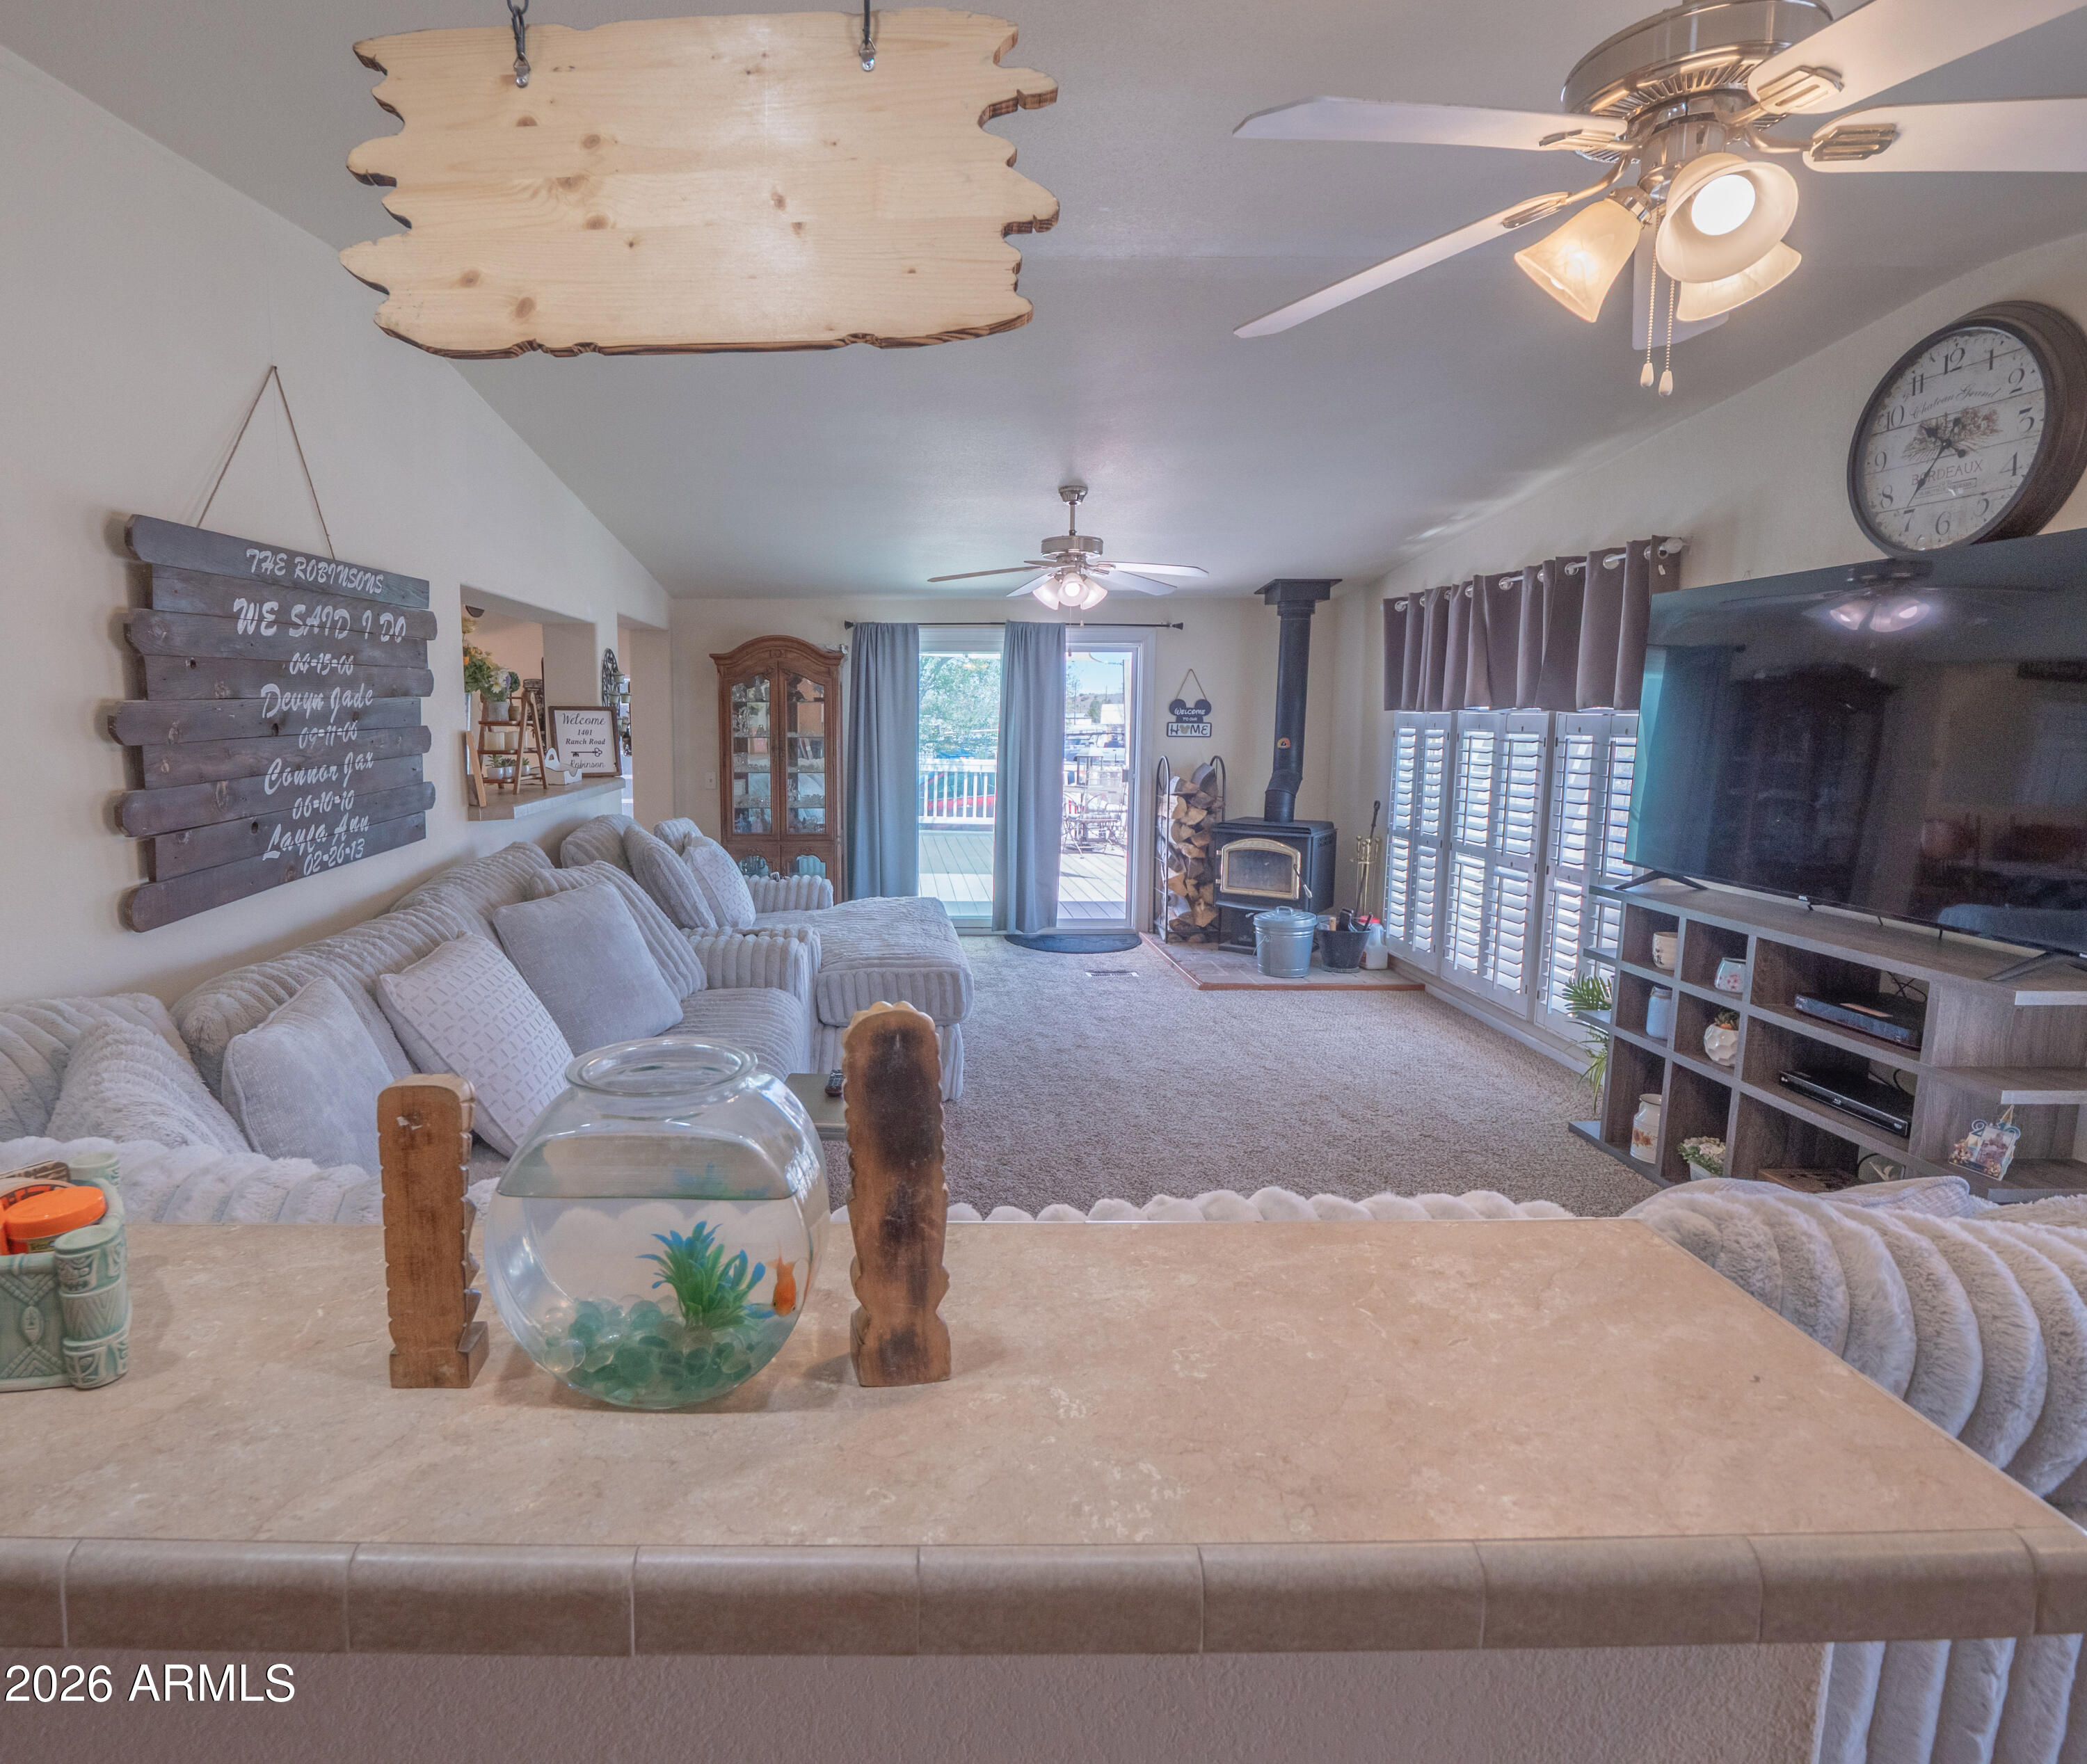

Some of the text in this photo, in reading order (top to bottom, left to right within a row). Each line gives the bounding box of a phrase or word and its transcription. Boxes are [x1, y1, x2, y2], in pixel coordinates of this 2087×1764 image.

[1944, 347, 1965, 375] 12
[1987, 348, 1994, 370] 1
[1911, 374, 1924, 396] 11
[2008, 368, 2024, 394] 2
[1885, 406, 1905, 431] 10
[2019, 408, 2034, 433] 3
[1875, 451, 1887, 472] 9
[1999, 452, 2022, 476] 4
[1880, 485, 1894, 508] 8
[1903, 508, 1915, 532] 7
[1935, 511, 1951, 535] 6
[246, 548, 384, 594] THE ROBINSONS
[233, 598, 406, 643] WE SAID I DO
[260, 682, 374, 723] Devyn Jade
[563, 712, 605, 725] Welcome
[298, 720, 358, 749] 09-11-06
[264, 751, 374, 795] Connor Jax
[292, 789, 355, 819] 06-10-10
[262, 812, 371, 861] Layla Ann
